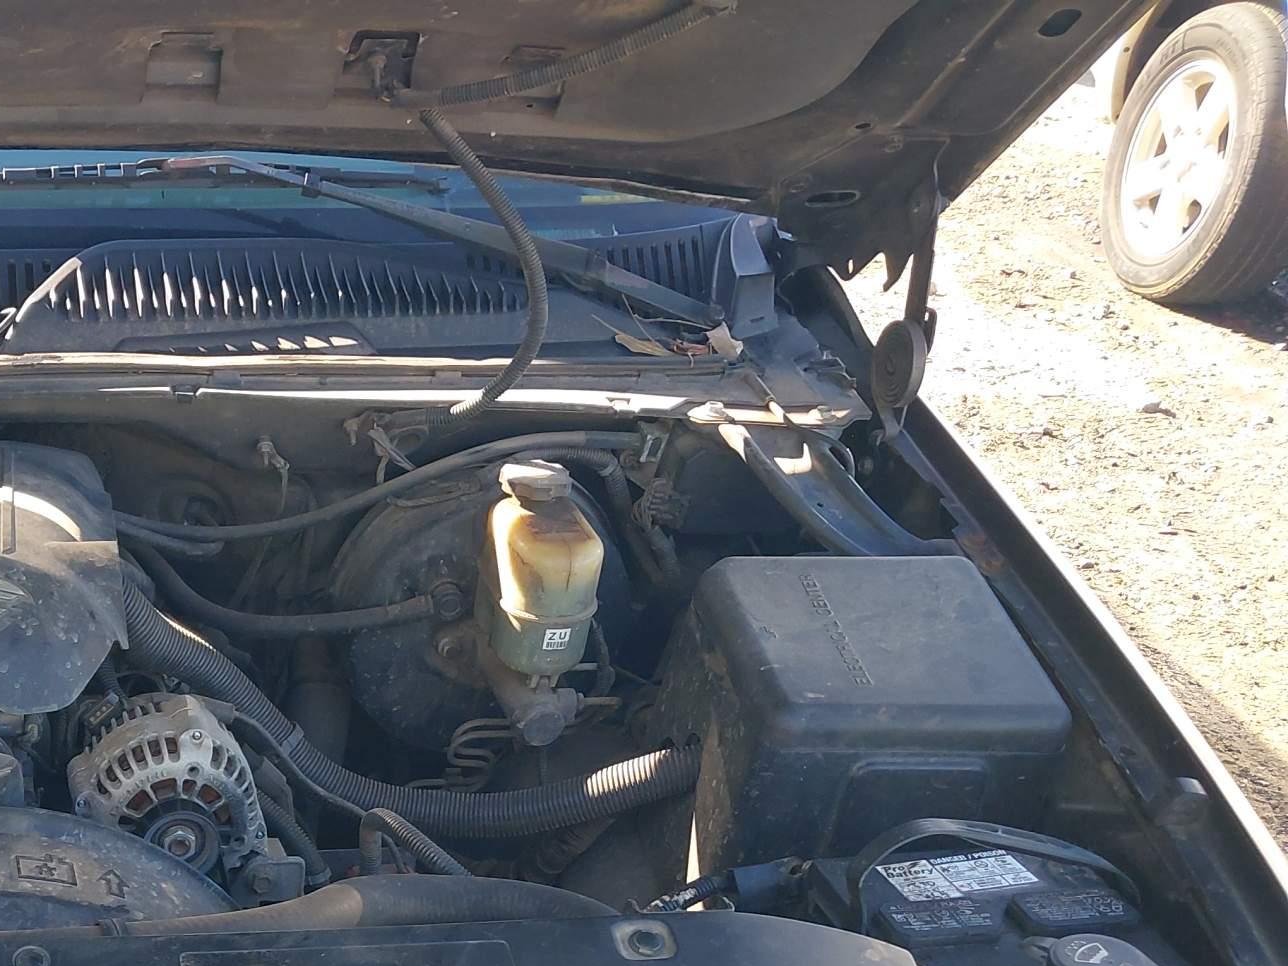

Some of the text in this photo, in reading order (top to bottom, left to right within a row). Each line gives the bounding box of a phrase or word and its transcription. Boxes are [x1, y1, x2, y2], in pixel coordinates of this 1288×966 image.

[799, 574, 834, 617] CENTER
[882, 865, 906, 873] Pro
[886, 868, 934, 880] Battery
